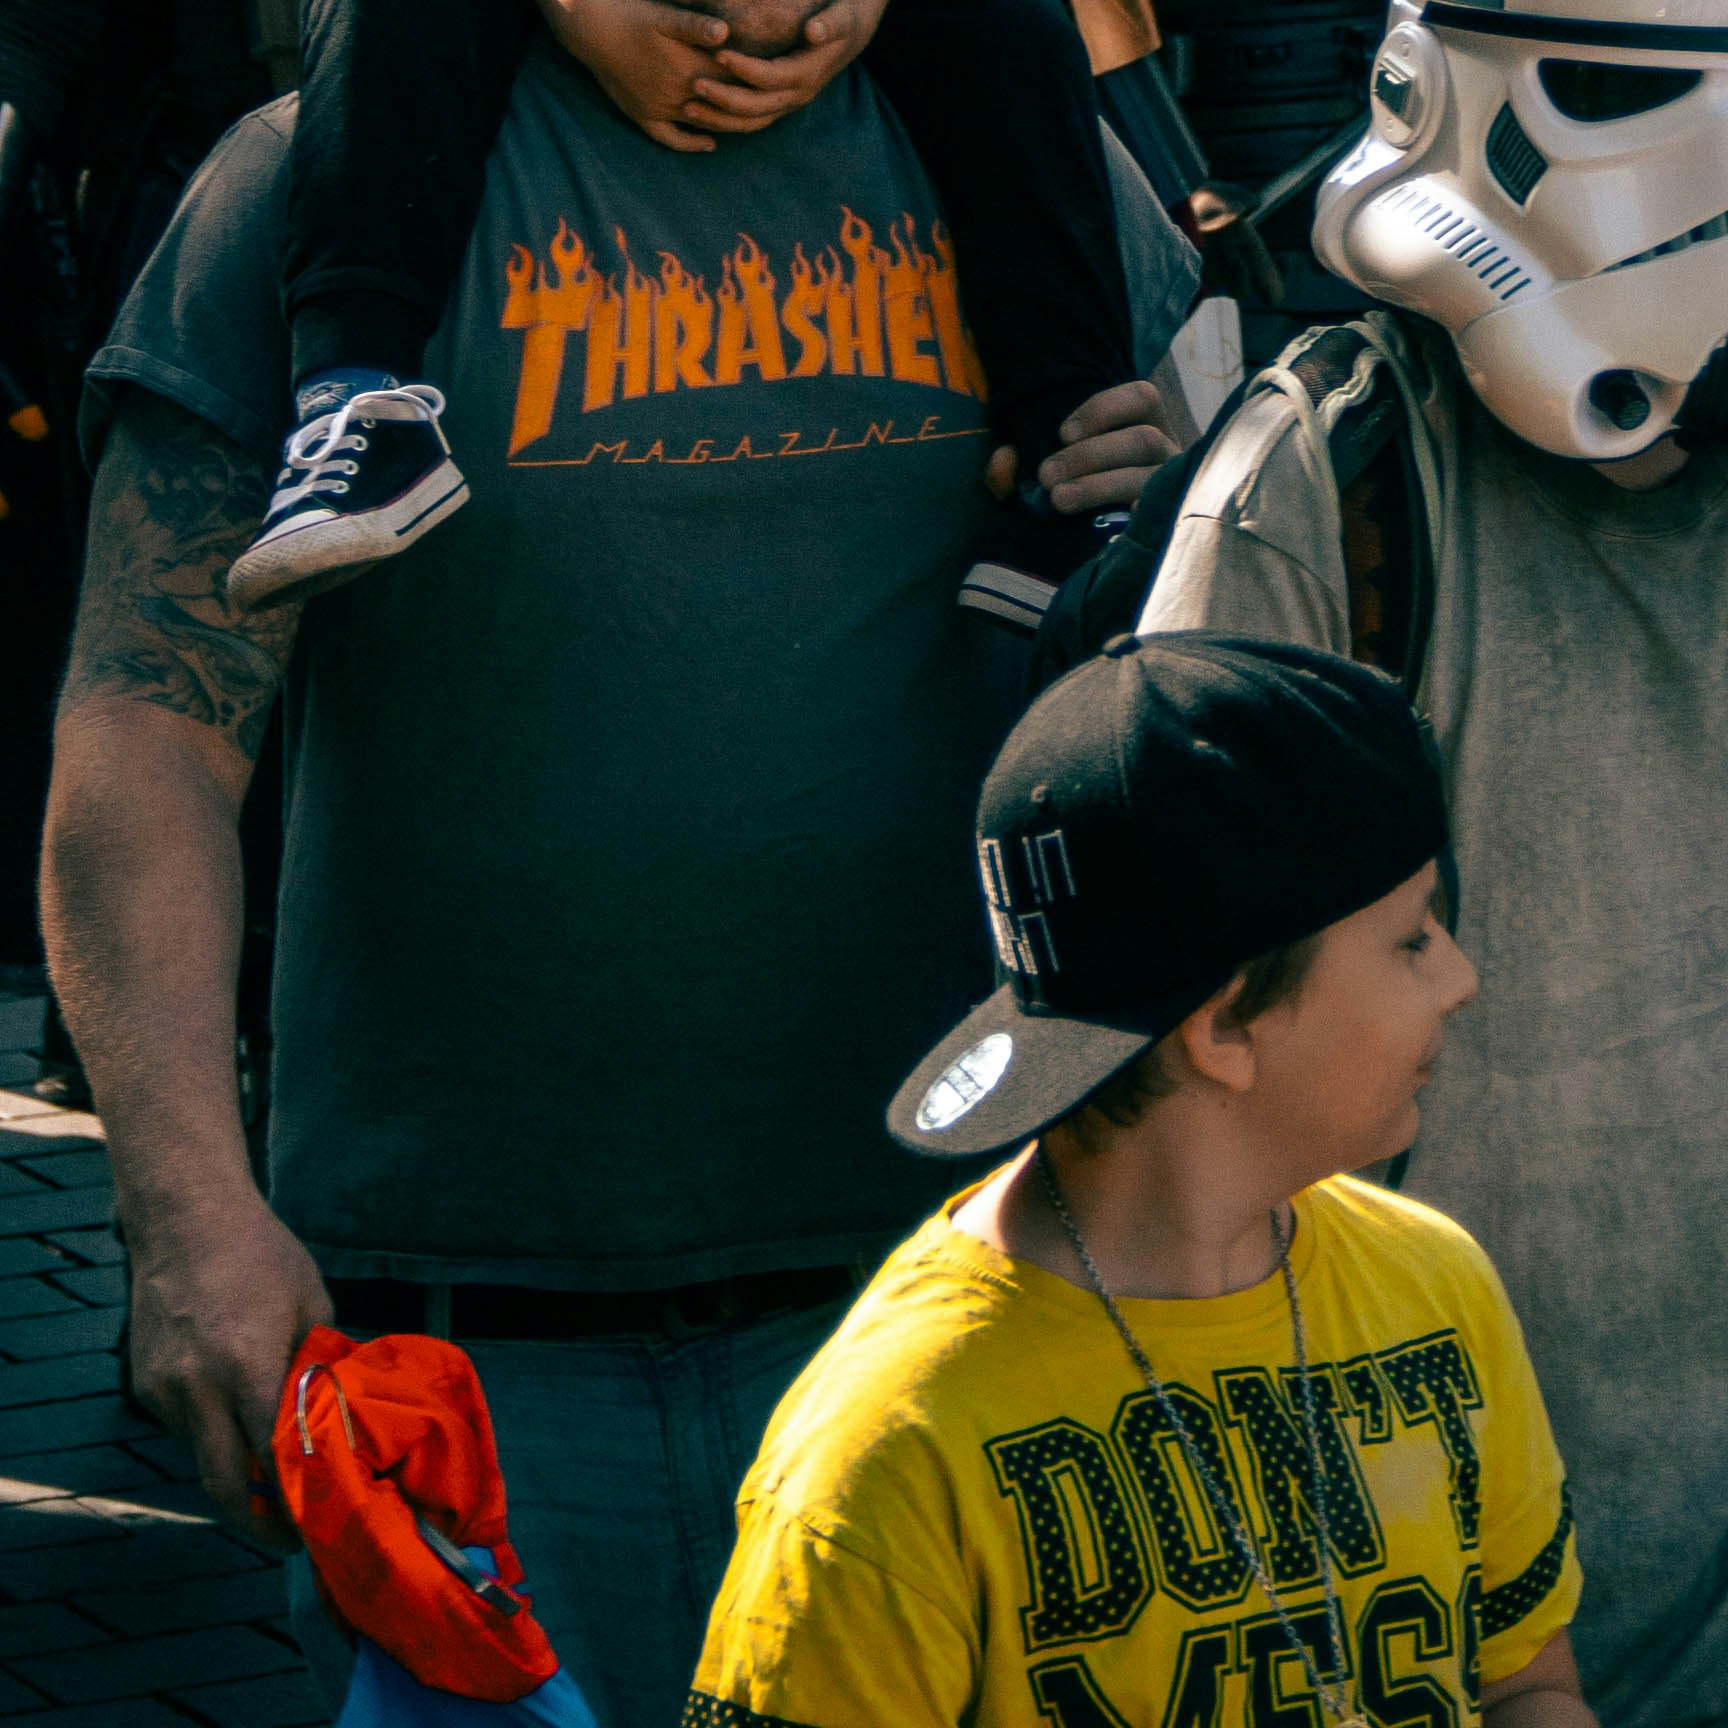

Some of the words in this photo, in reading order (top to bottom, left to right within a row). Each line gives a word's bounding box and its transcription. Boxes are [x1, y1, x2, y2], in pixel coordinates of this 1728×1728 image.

[586, 415, 945, 464] MAGAZINE
[982, 1327, 1484, 1656] DON'T
[1026, 1562, 1482, 1728] ES
